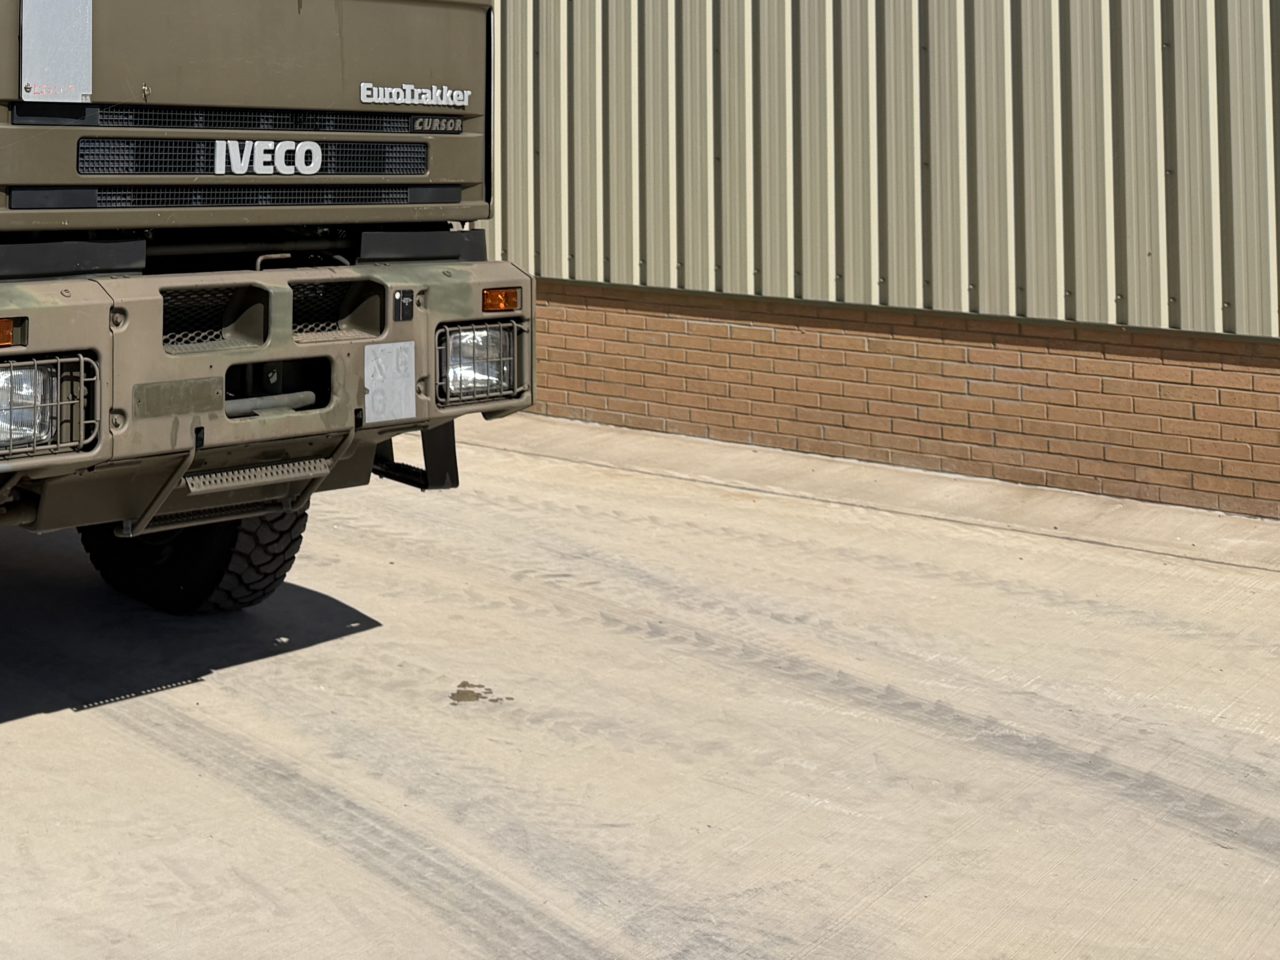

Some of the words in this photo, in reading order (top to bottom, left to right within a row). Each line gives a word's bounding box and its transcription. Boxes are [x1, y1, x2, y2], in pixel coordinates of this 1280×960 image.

[360, 82, 472, 107] EuroTrakker
[414, 118, 463, 132] CURSOR
[214, 139, 323, 176] IVECO
